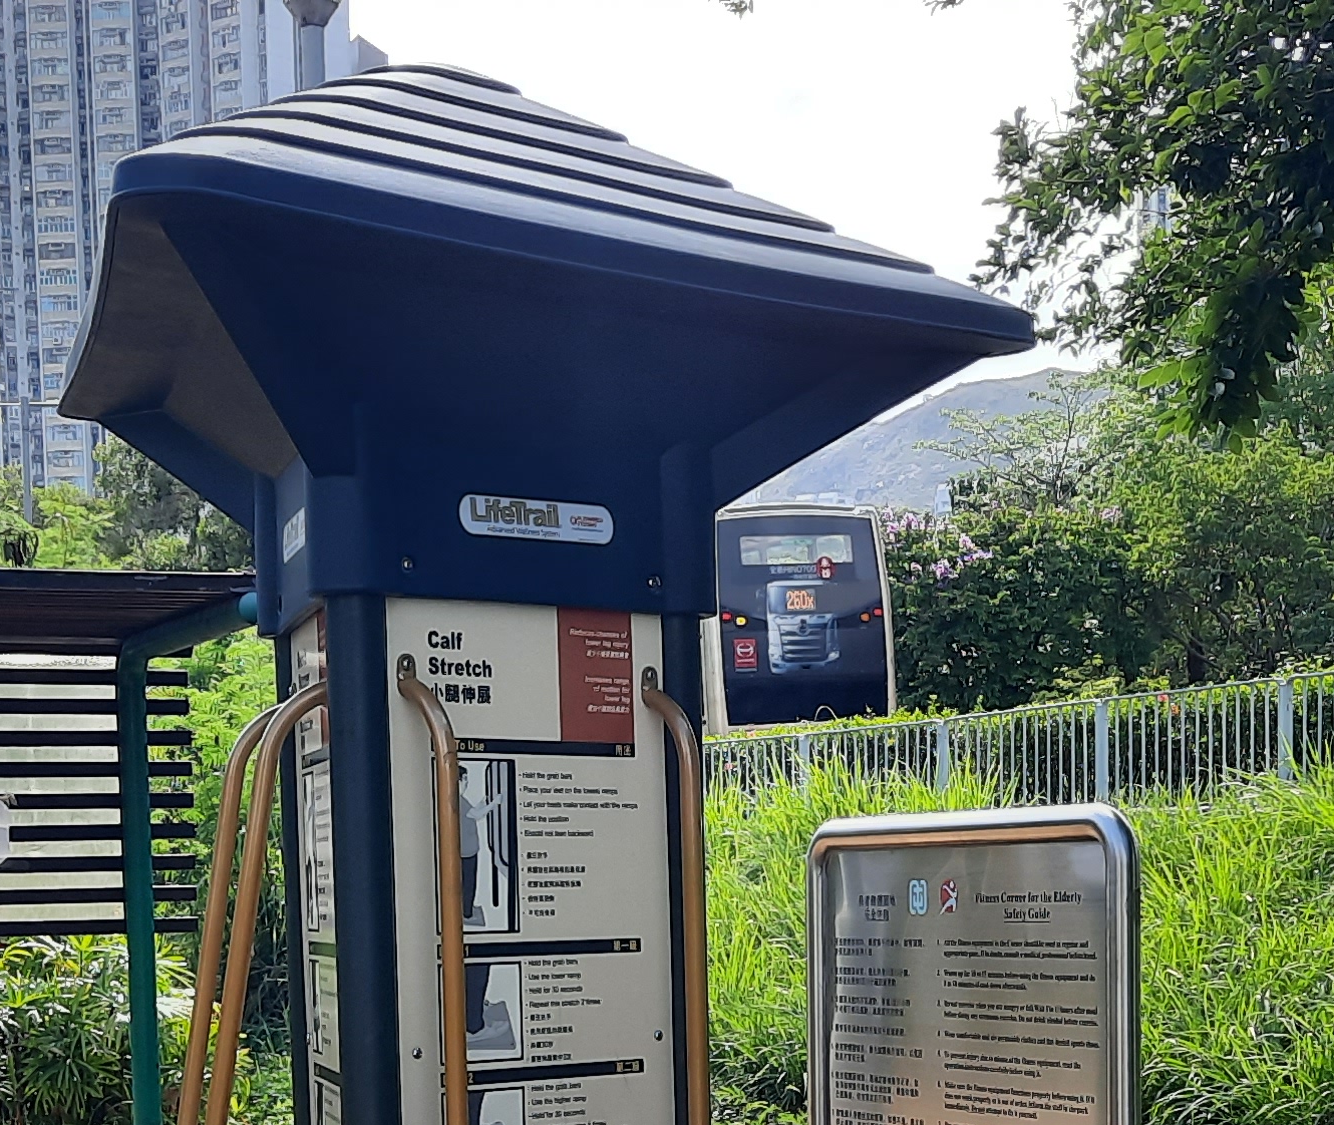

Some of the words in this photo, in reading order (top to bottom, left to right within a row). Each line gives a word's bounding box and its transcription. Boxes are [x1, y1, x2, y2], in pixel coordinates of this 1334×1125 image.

[469, 496, 560, 528] LifeTrail
[427, 630, 463, 650] Calf
[428, 656, 492, 678] Stretch
[468, 740, 485, 752] Use
[1027, 891, 1039, 903] for
[1040, 890, 1052, 903] the
[1053, 890, 1082, 905] Elderly
[467, 1072, 474, 1084] 2
